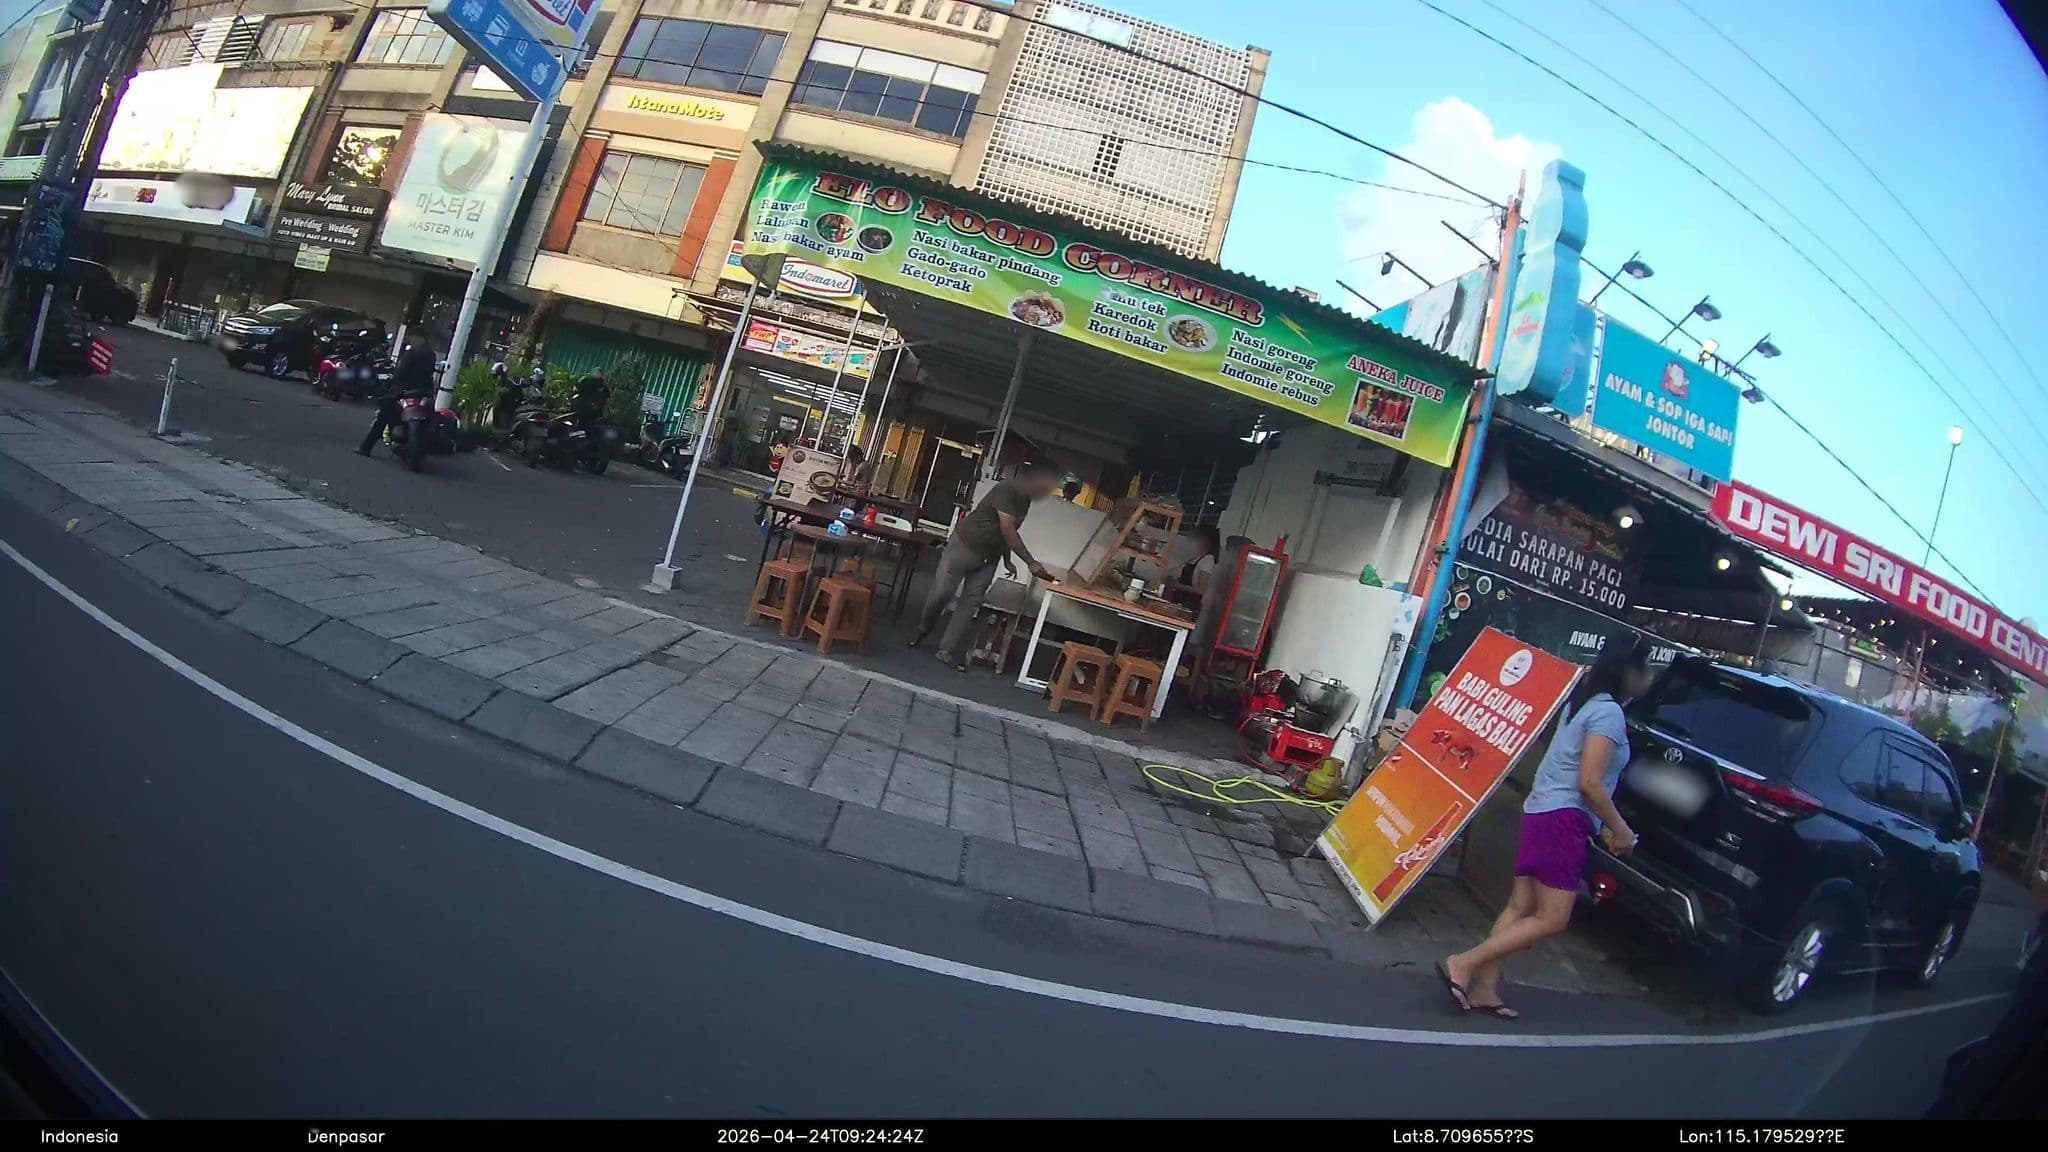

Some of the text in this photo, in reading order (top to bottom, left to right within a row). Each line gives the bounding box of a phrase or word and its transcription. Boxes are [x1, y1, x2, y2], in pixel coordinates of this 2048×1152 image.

[286, 182, 345, 206] Mary Lynn
[351, 205, 375, 215] SALON
[281, 216, 360, 238] Pre Wedding Wedding
[408, 221, 475, 239] MASTER KIM
[783, 230, 824, 252] bakar
[827, 245, 864, 262] ayam
[810, 171, 1264, 327] ELO FOOD CORNER
[907, 248, 987, 280] Gado-gado
[913, 231, 1061, 287] Nasi bakar pindang
[781, 263, 850, 290] Indomaret
[900, 264, 972, 293] Ketoprak
[1093, 302, 1159, 332] Karedok
[1141, 299, 1167, 317] tek
[1088, 319, 1168, 354] Roti bakar
[1232, 329, 1317, 371] Nasi goreng
[1221, 363, 1319, 406] Indomie rebus
[1226, 346, 1334, 395] Indomie goreng
[1346, 355, 1444, 402] ANEKA JUICE
[1605, 372, 1733, 447] AYAM & SOP IGA SAPI
[1646, 414, 1696, 450] JONTOR
[1478, 517, 1623, 587] DIA SARAPAN PAGI
[1728, 488, 1838, 566] DEWI
[1844, 542, 1905, 597] SRI
[1908, 574, 1988, 640] FOOD
[1509, 550, 1548, 579] DARI
[1551, 566, 1573, 590] RP.
[1579, 578, 1626, 610] 15.000
[1569, 630, 1598, 649] AYAM
[1596, 635, 1606, 651] &
[1456, 671, 1534, 727] BABI GULING
[1453, 699, 1499, 738] LAGAS
[1486, 720, 1527, 757] BALI
